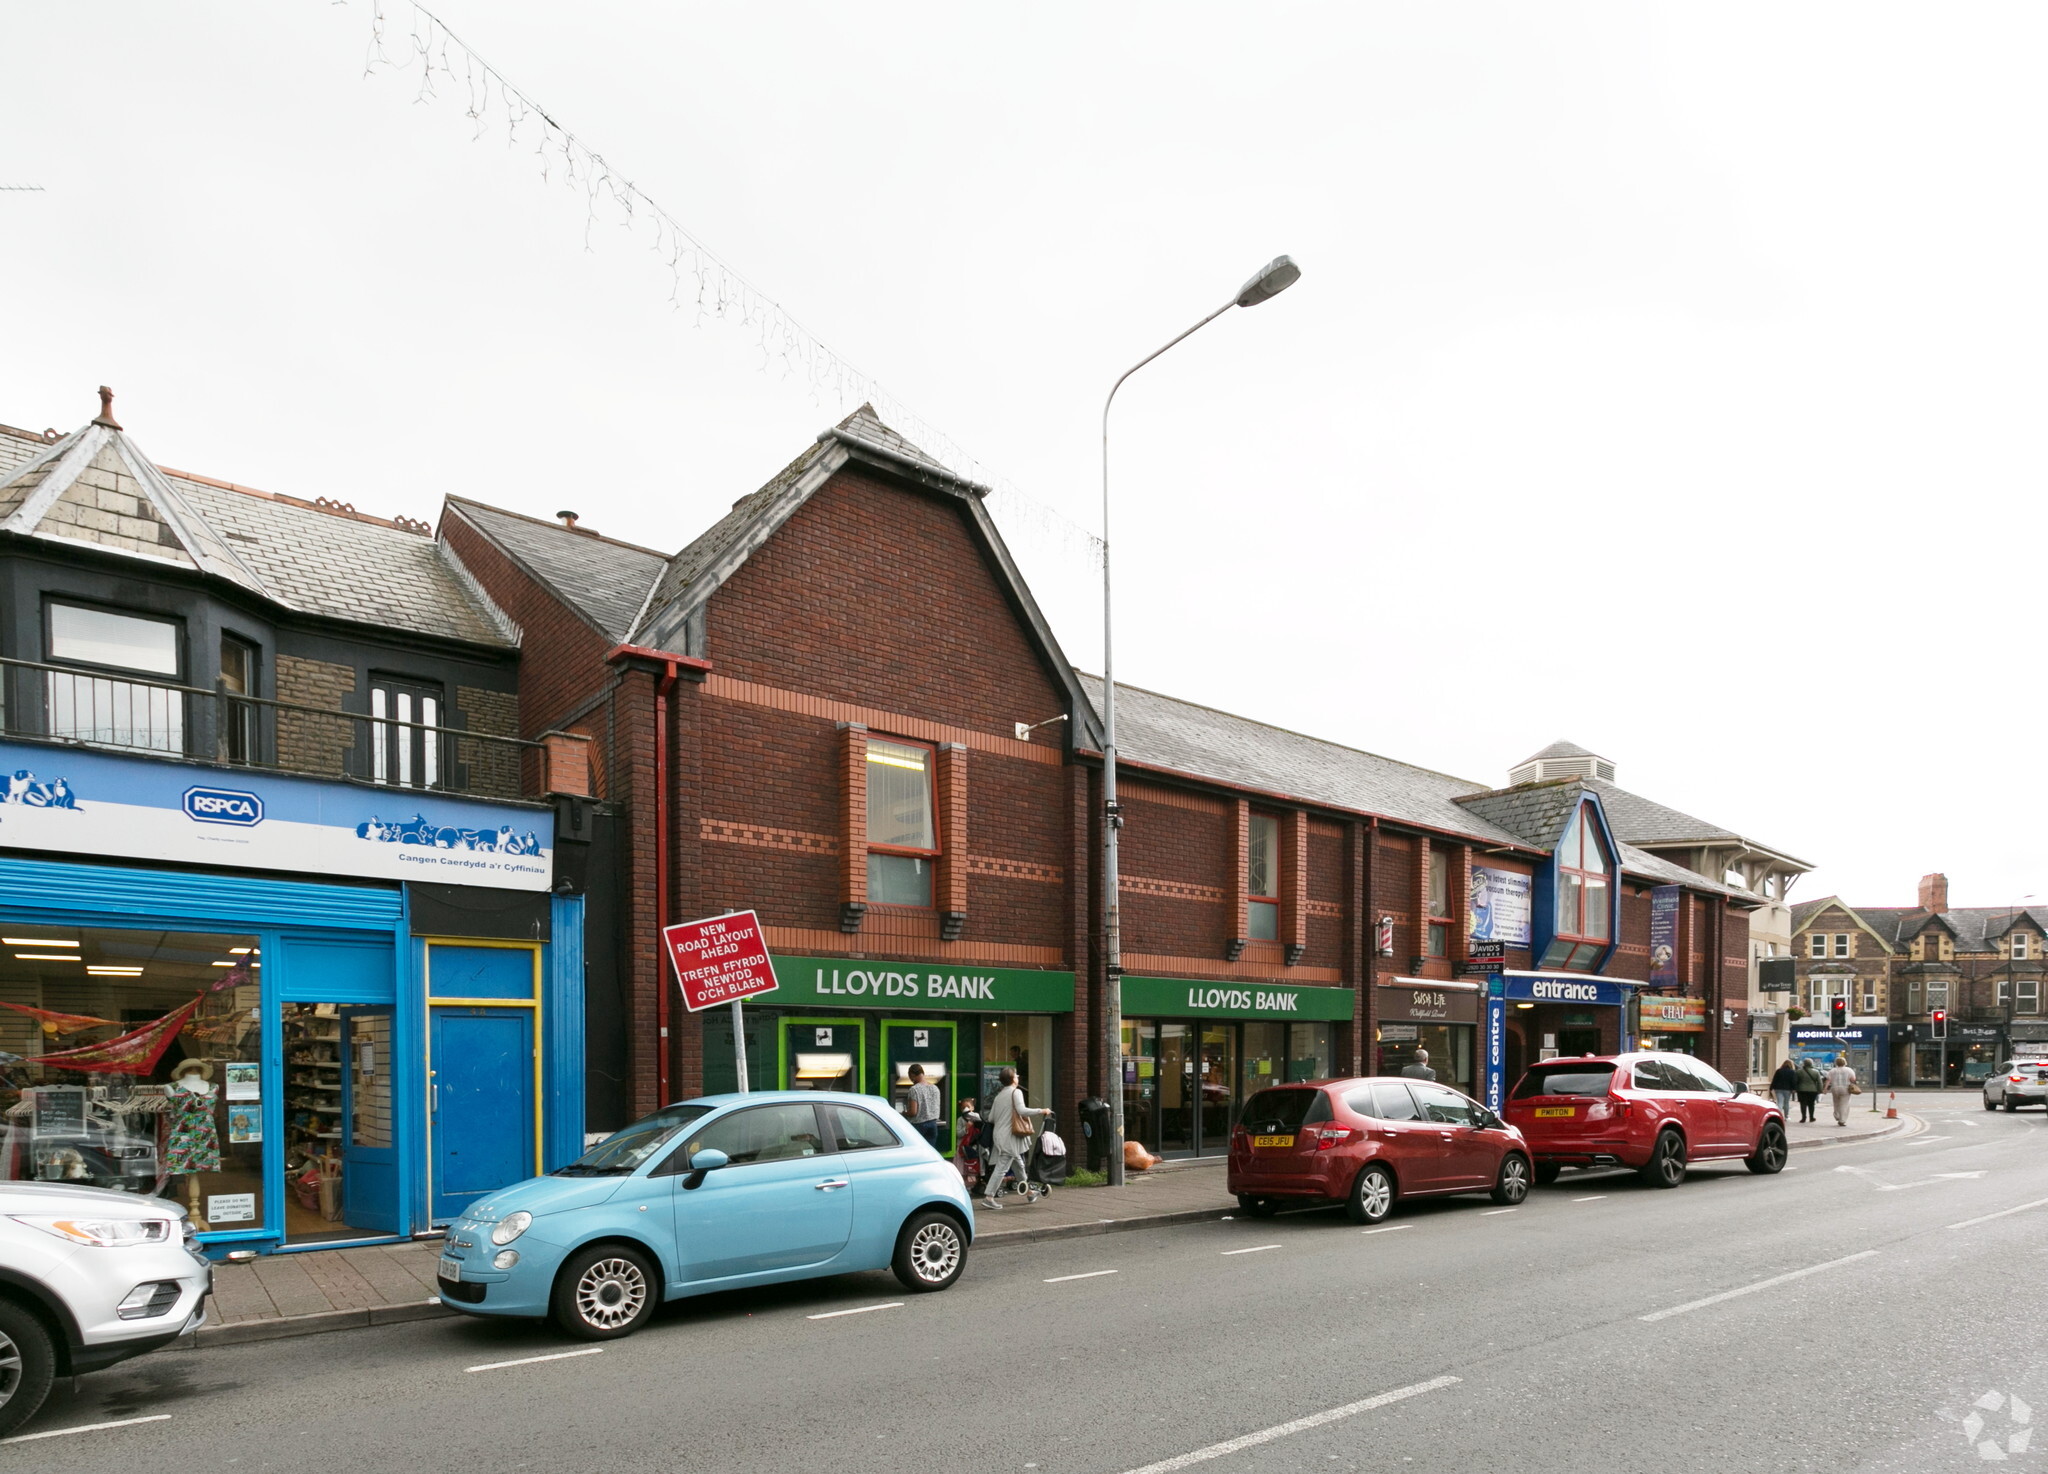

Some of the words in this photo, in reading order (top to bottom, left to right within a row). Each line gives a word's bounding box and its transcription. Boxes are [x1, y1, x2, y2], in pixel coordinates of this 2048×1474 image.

[194, 796, 255, 817] RSPCA
[399, 853, 437, 865] Cangen
[440, 858, 486, 869] Caerdydd
[489, 862, 501, 870] a'r
[504, 863, 545, 874] Cyffiniau
[677, 938, 709, 953] ROAD
[713, 928, 754, 945] LAYOUT
[700, 923, 726, 937] NEW
[701, 943, 739, 960] AHEAD
[682, 965, 719, 982] TREFN
[723, 954, 765, 972] FFYRDD
[704, 968, 752, 988] NEWYDD
[697, 987, 725, 1001] O'CH
[729, 976, 765, 994] BLAEN
[816, 969, 919, 997] LLOYDS
[927, 974, 995, 1000] BANK
[1532, 980, 1598, 1000] entrance
[1188, 988, 1251, 1009] LLOYDS
[1256, 991, 1298, 1011] BANK
[1662, 1005, 1684, 1020] CHAI
[1491, 1008, 1500, 1065] centre
